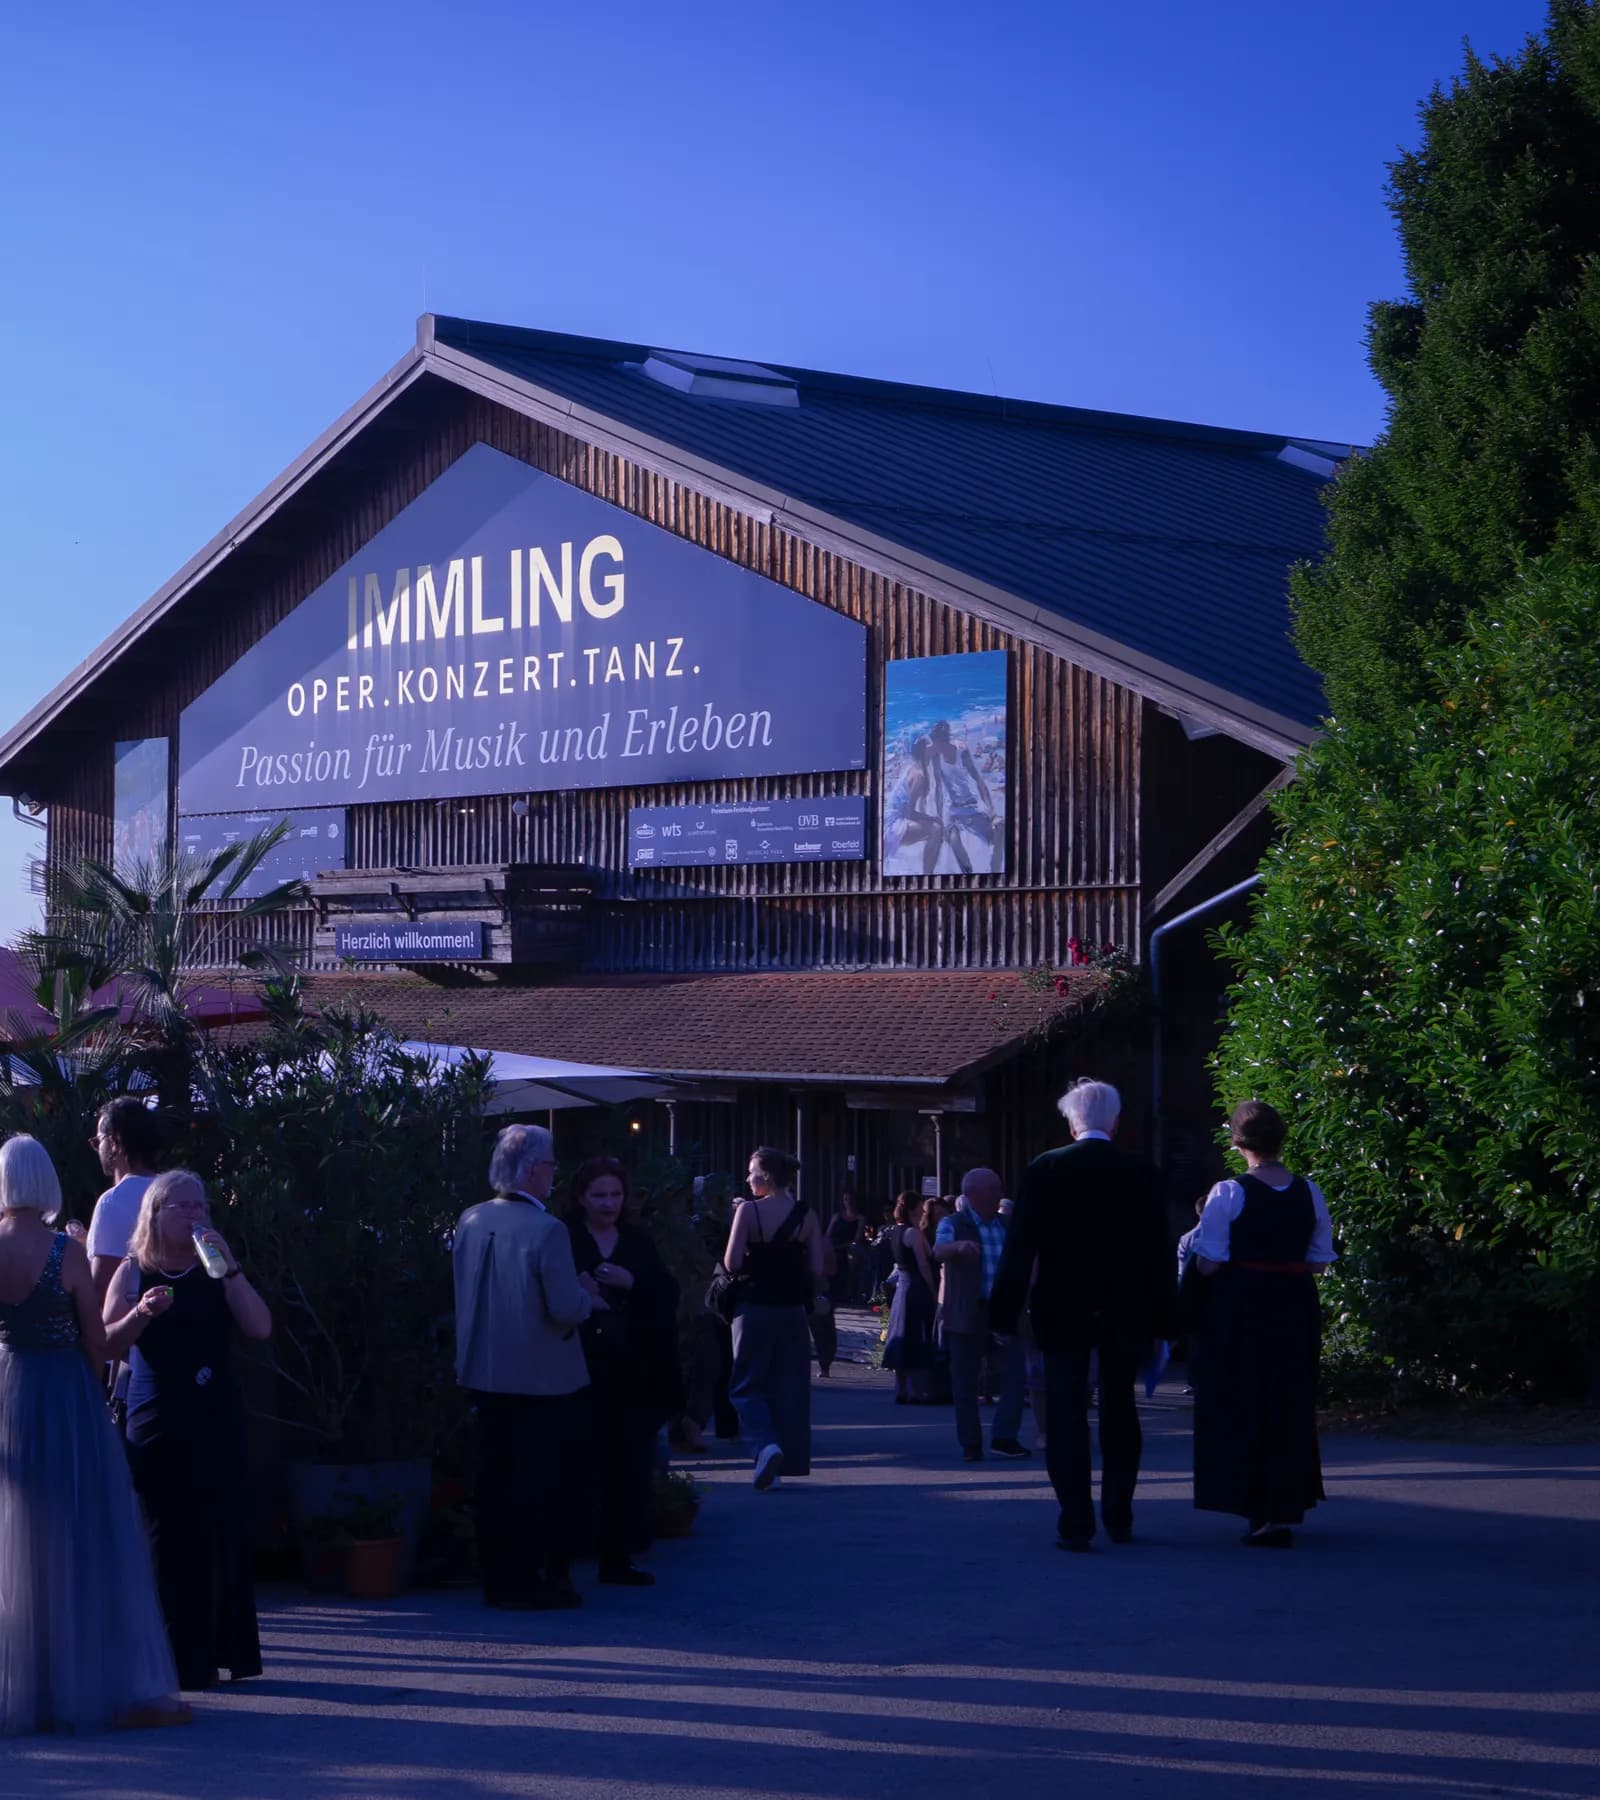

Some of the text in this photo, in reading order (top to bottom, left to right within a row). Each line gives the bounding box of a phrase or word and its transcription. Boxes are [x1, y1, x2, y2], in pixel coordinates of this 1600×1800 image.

[347, 534, 625, 650] IMMLING
[287, 636, 701, 717] OPER.KONZERT.TANZ.
[235, 702, 773, 789] Passion für Musik und Erleben
[342, 931, 475, 950] Herzlich willkommen!
